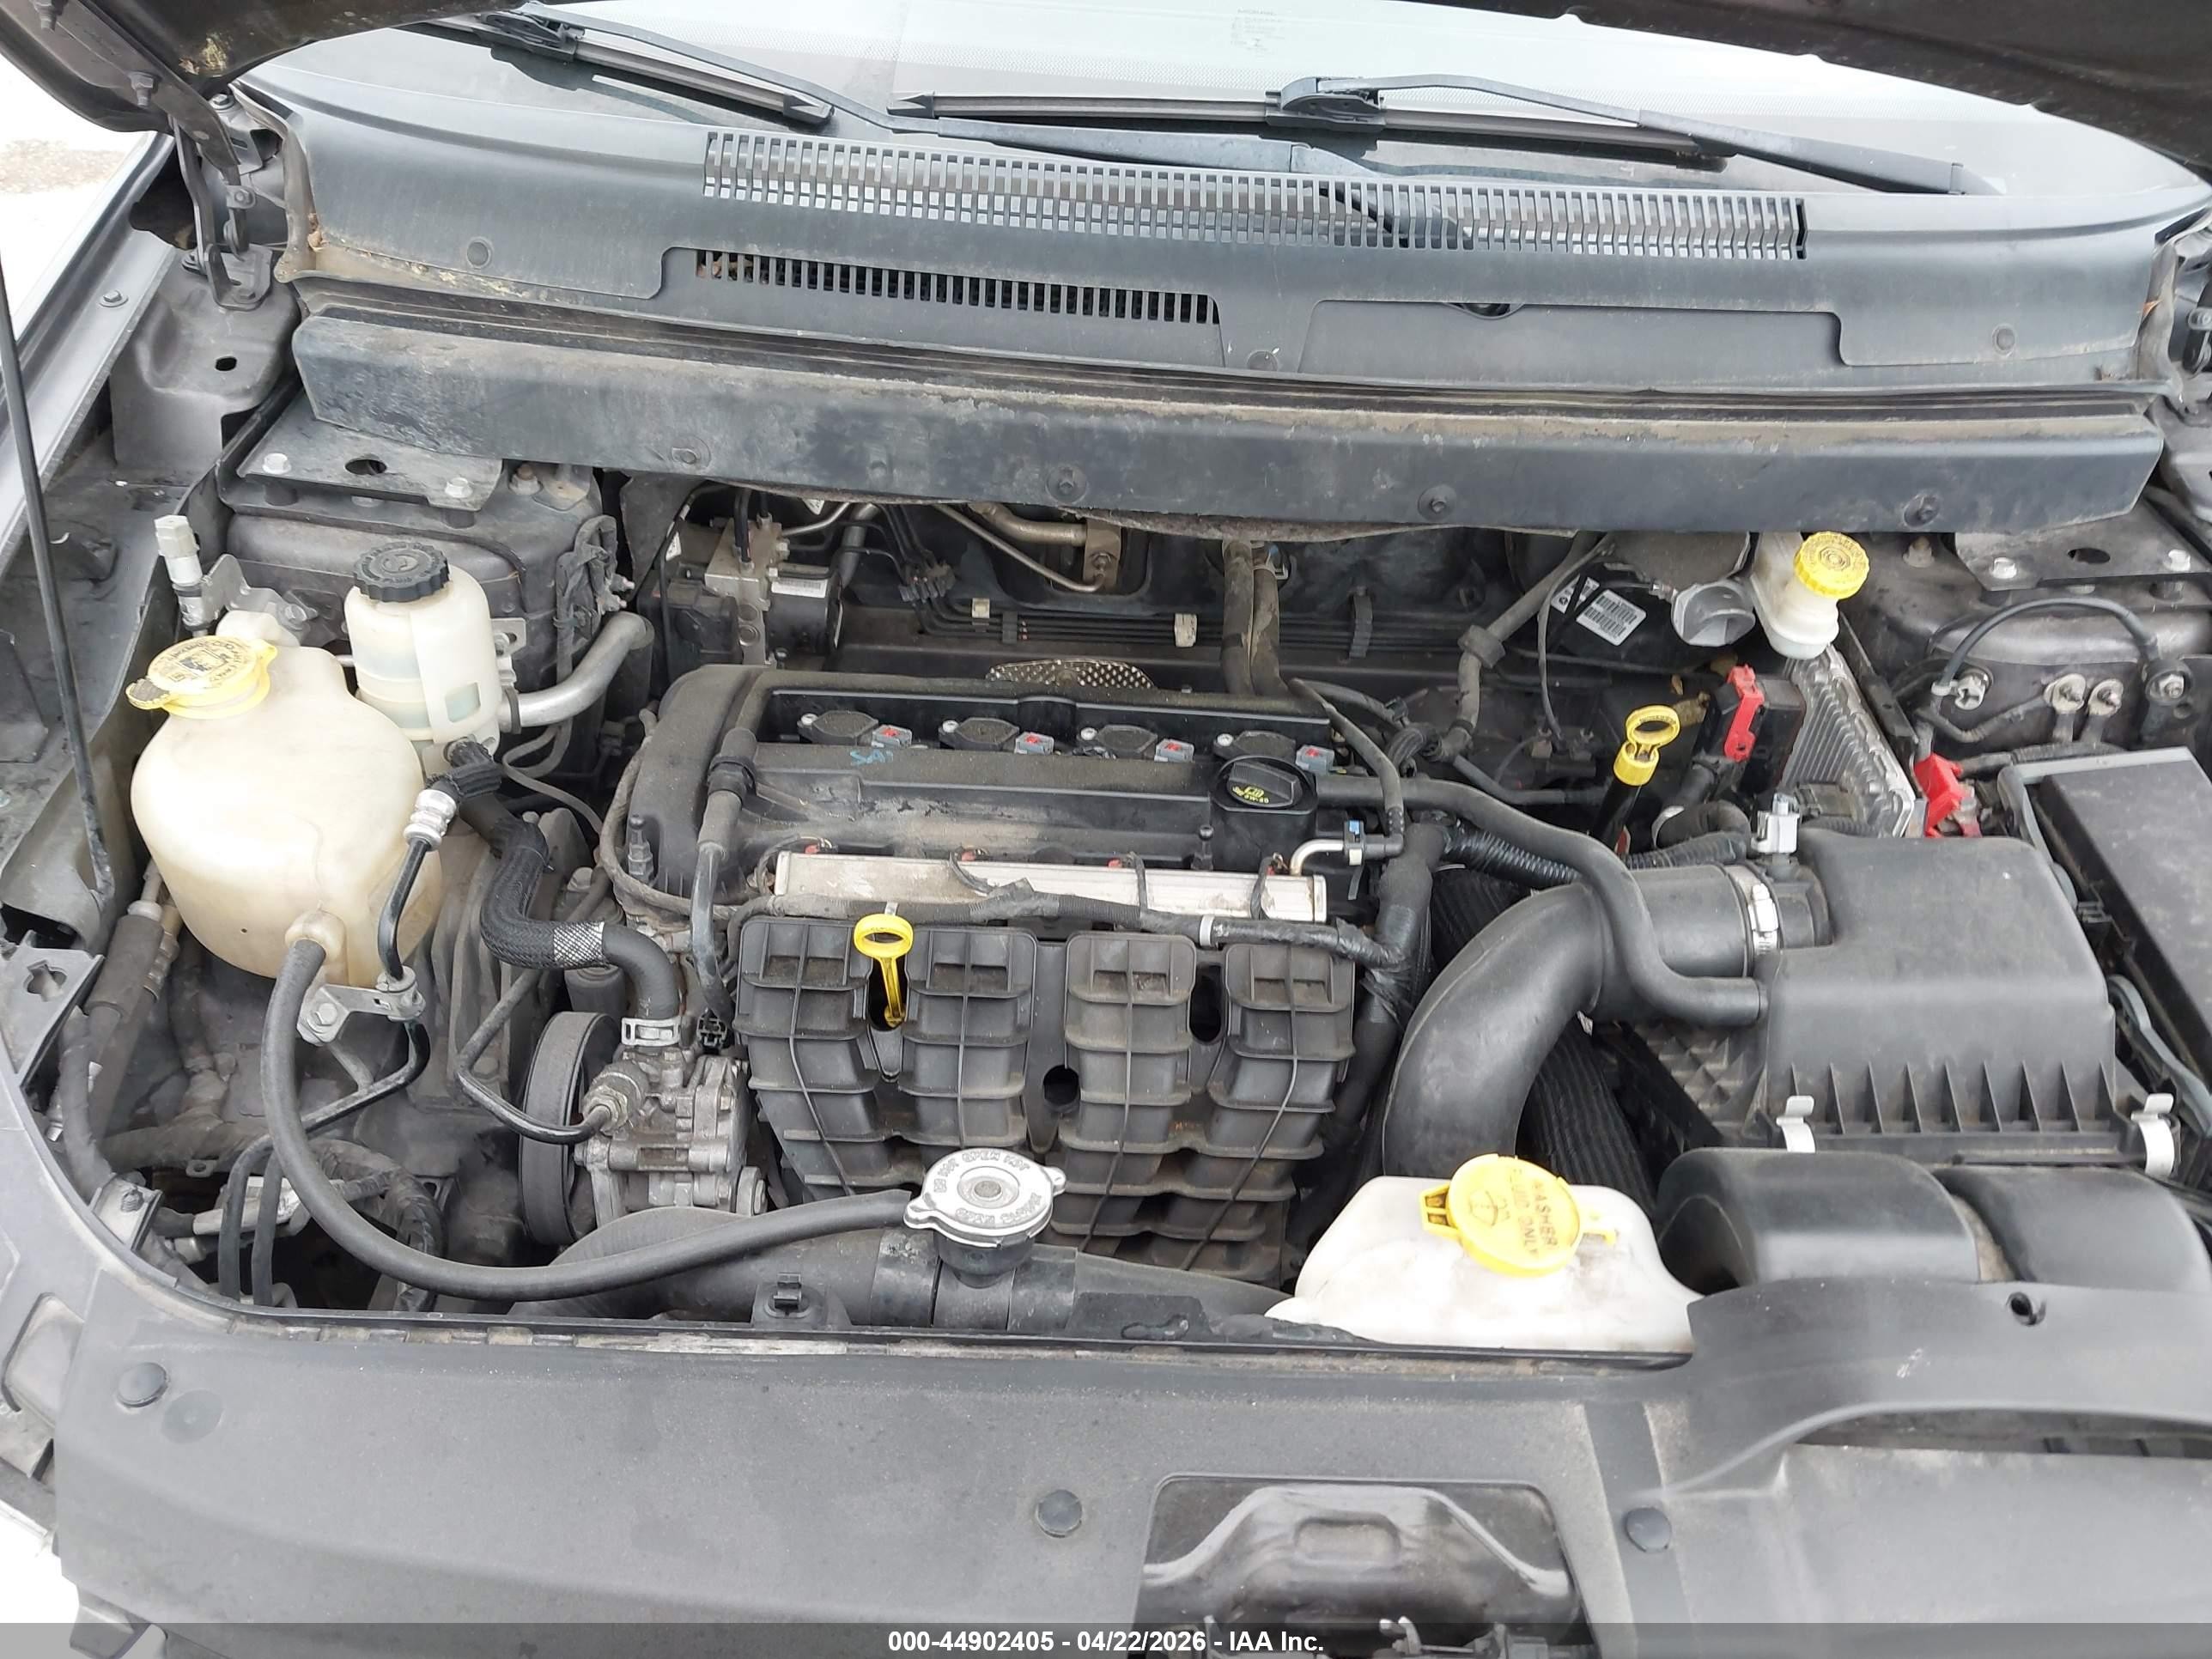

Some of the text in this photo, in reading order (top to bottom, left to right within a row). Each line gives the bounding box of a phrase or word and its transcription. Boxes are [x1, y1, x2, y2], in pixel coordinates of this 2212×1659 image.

[961, 1149, 1001, 1162] OPEN
[1003, 1154, 1031, 1171] HOT
[1531, 1178, 1559, 1250] WASHER
[1517, 1215, 1540, 1256] ONLY
